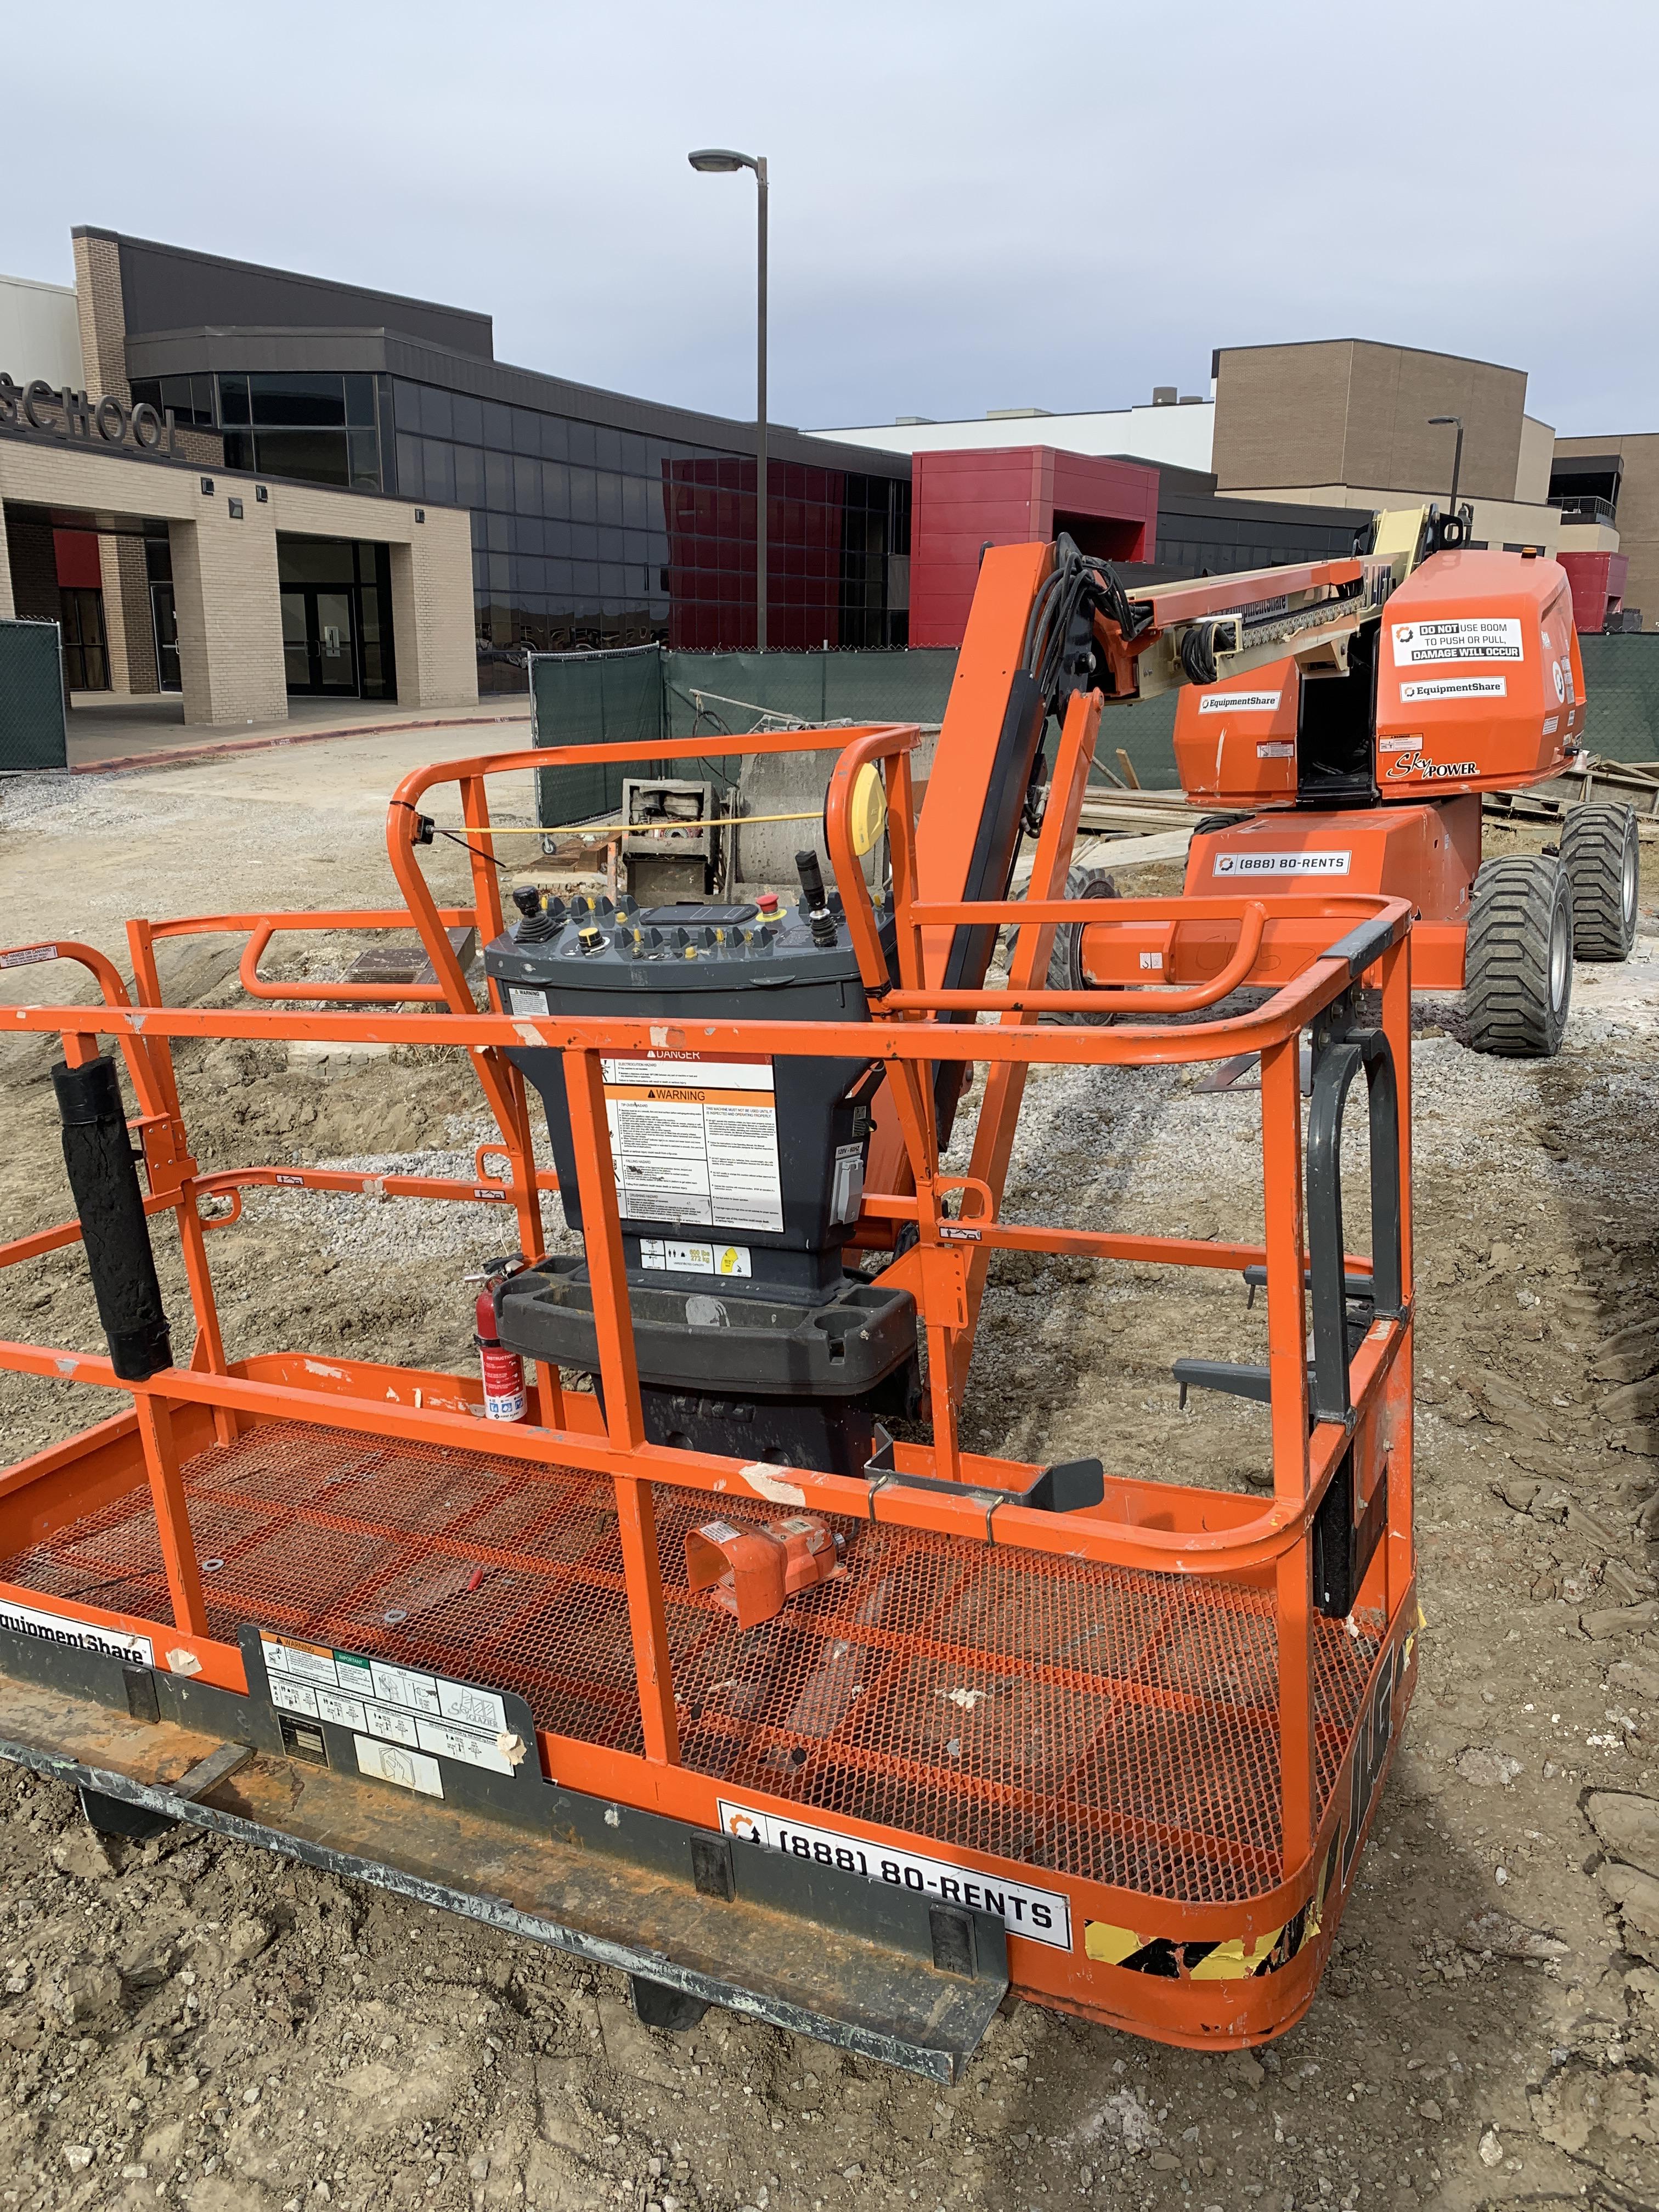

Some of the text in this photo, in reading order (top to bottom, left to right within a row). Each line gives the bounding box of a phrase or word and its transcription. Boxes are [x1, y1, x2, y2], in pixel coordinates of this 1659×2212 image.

[1421, 626, 1436, 635] DO
[1438, 624, 1458, 634] NOT
[1460, 624, 1478, 632] USE
[1425, 638, 1437, 646] TO
[1483, 636, 1506, 644] PULL,
[1413, 647, 1519, 660] DAMAGE WILL OCCUR
[1417, 683, 1500, 695] EquipmentShare
[1210, 697, 1276, 708] EquipmentShare
[1240, 858, 1344, 869] (888) 80-RENTS
[656, 1090, 705, 1101] WARNING
[284, 1638, 314, 1652] WARNING
[338, 1655, 363, 1665] IMPORTANT
[780, 1830, 1052, 1928] (888) 80-RENTS
